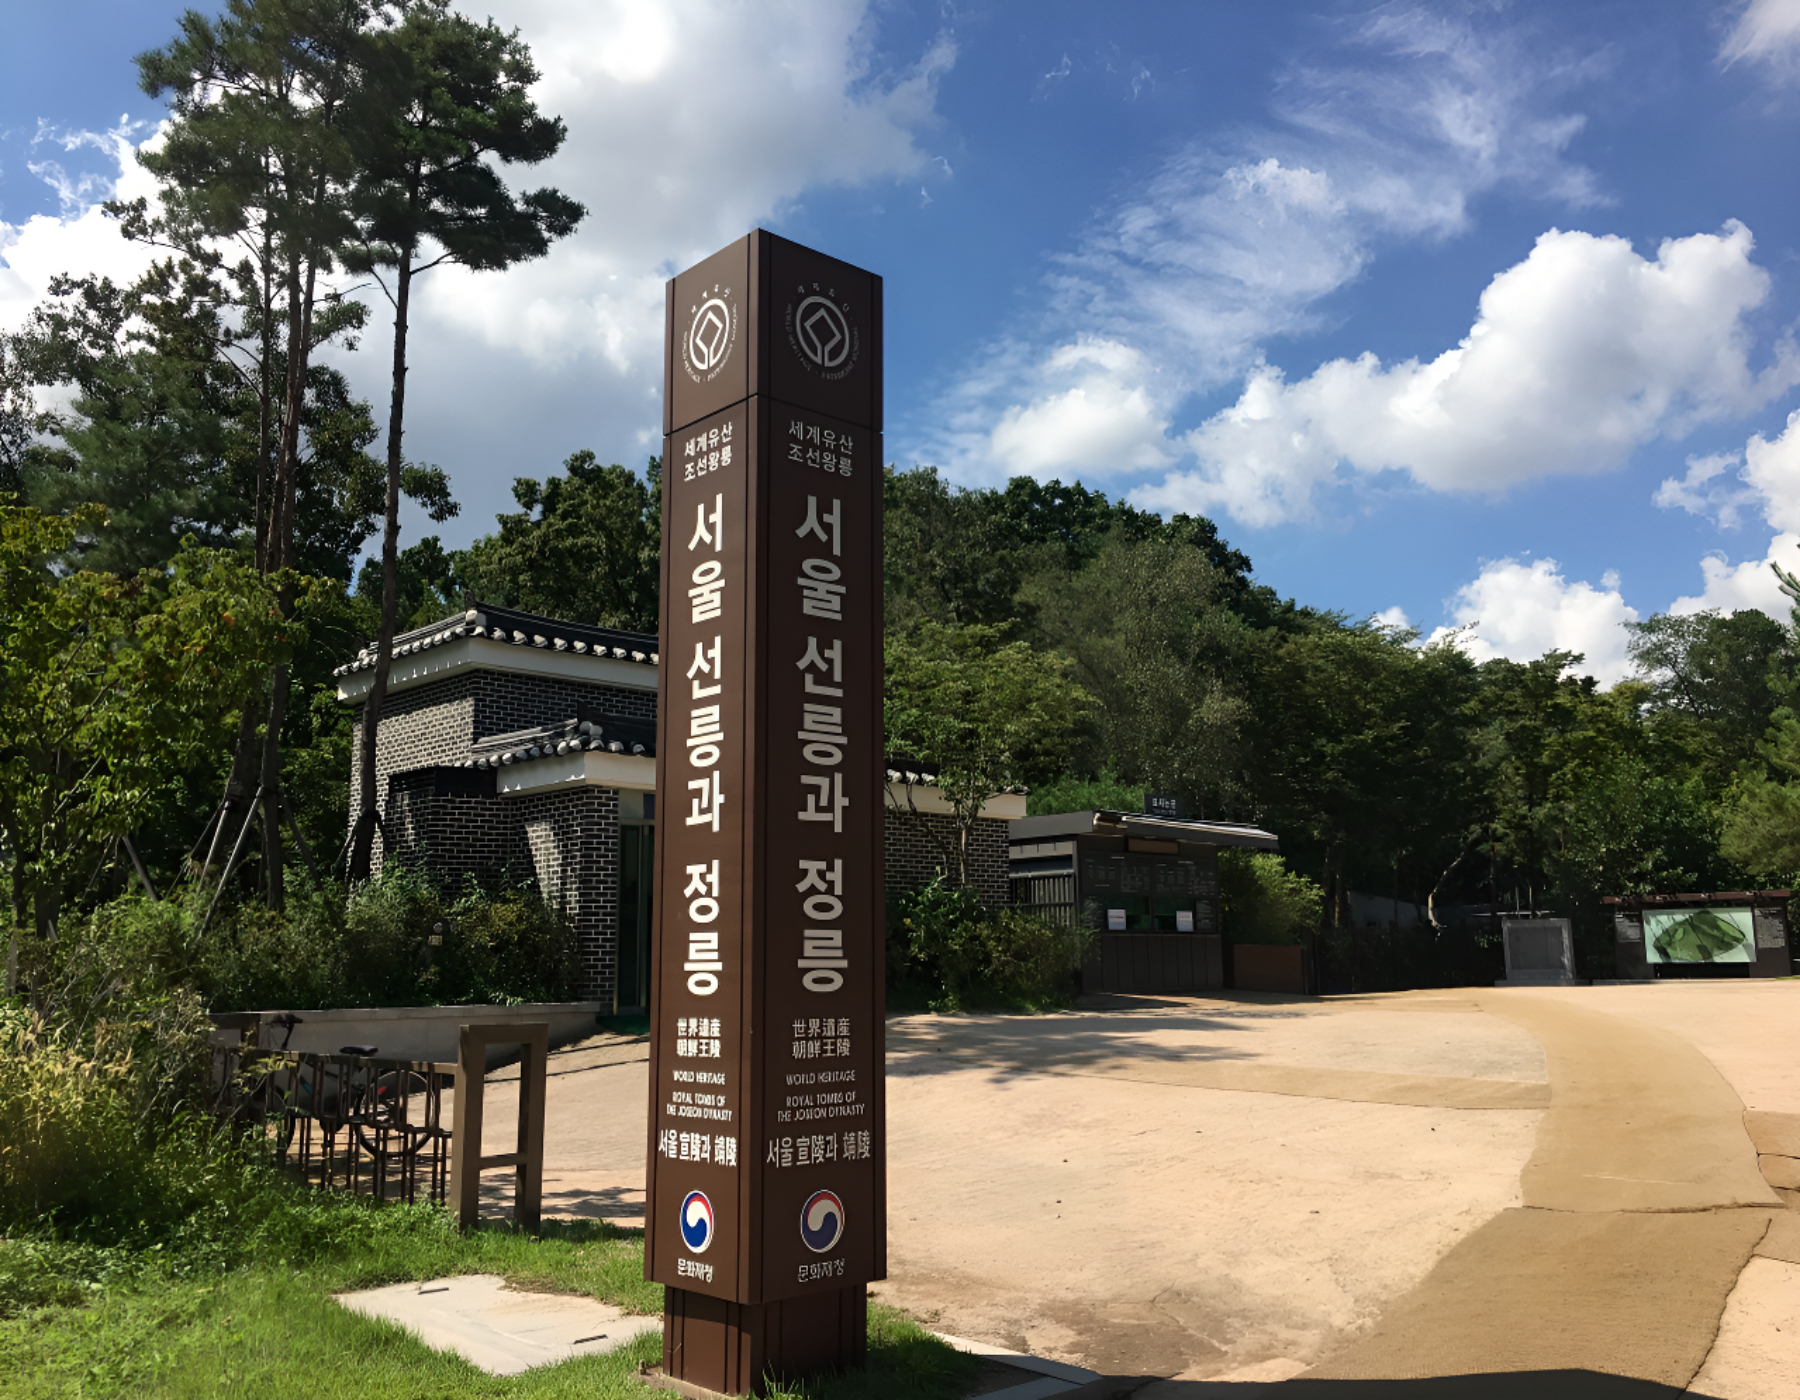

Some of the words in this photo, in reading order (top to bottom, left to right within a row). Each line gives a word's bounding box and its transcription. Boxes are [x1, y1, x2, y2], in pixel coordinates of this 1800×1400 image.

[684, 421, 732, 457] 세계유산
[788, 420, 853, 455] 세계유산
[687, 492, 726, 624] 서울
[795, 494, 847, 621] 서울
[686, 635, 725, 833] 선릉과
[795, 636, 849, 833] 선릉과
[683, 859, 723, 996] 정릉
[795, 858, 848, 993] 정릉
[673, 1070, 695, 1082] WORLD
[786, 1072, 816, 1085] WORLD
[818, 1069, 856, 1083] HERITAGE
[716, 1095, 725, 1107] OF
[786, 1094, 814, 1107] ROYAL
[845, 1091, 856, 1102] OF
[778, 1110, 792, 1122] THE
[659, 1128, 678, 1158] 서울
[766, 1137, 794, 1169] 서울
[677, 1257, 713, 1283] 문화재청
